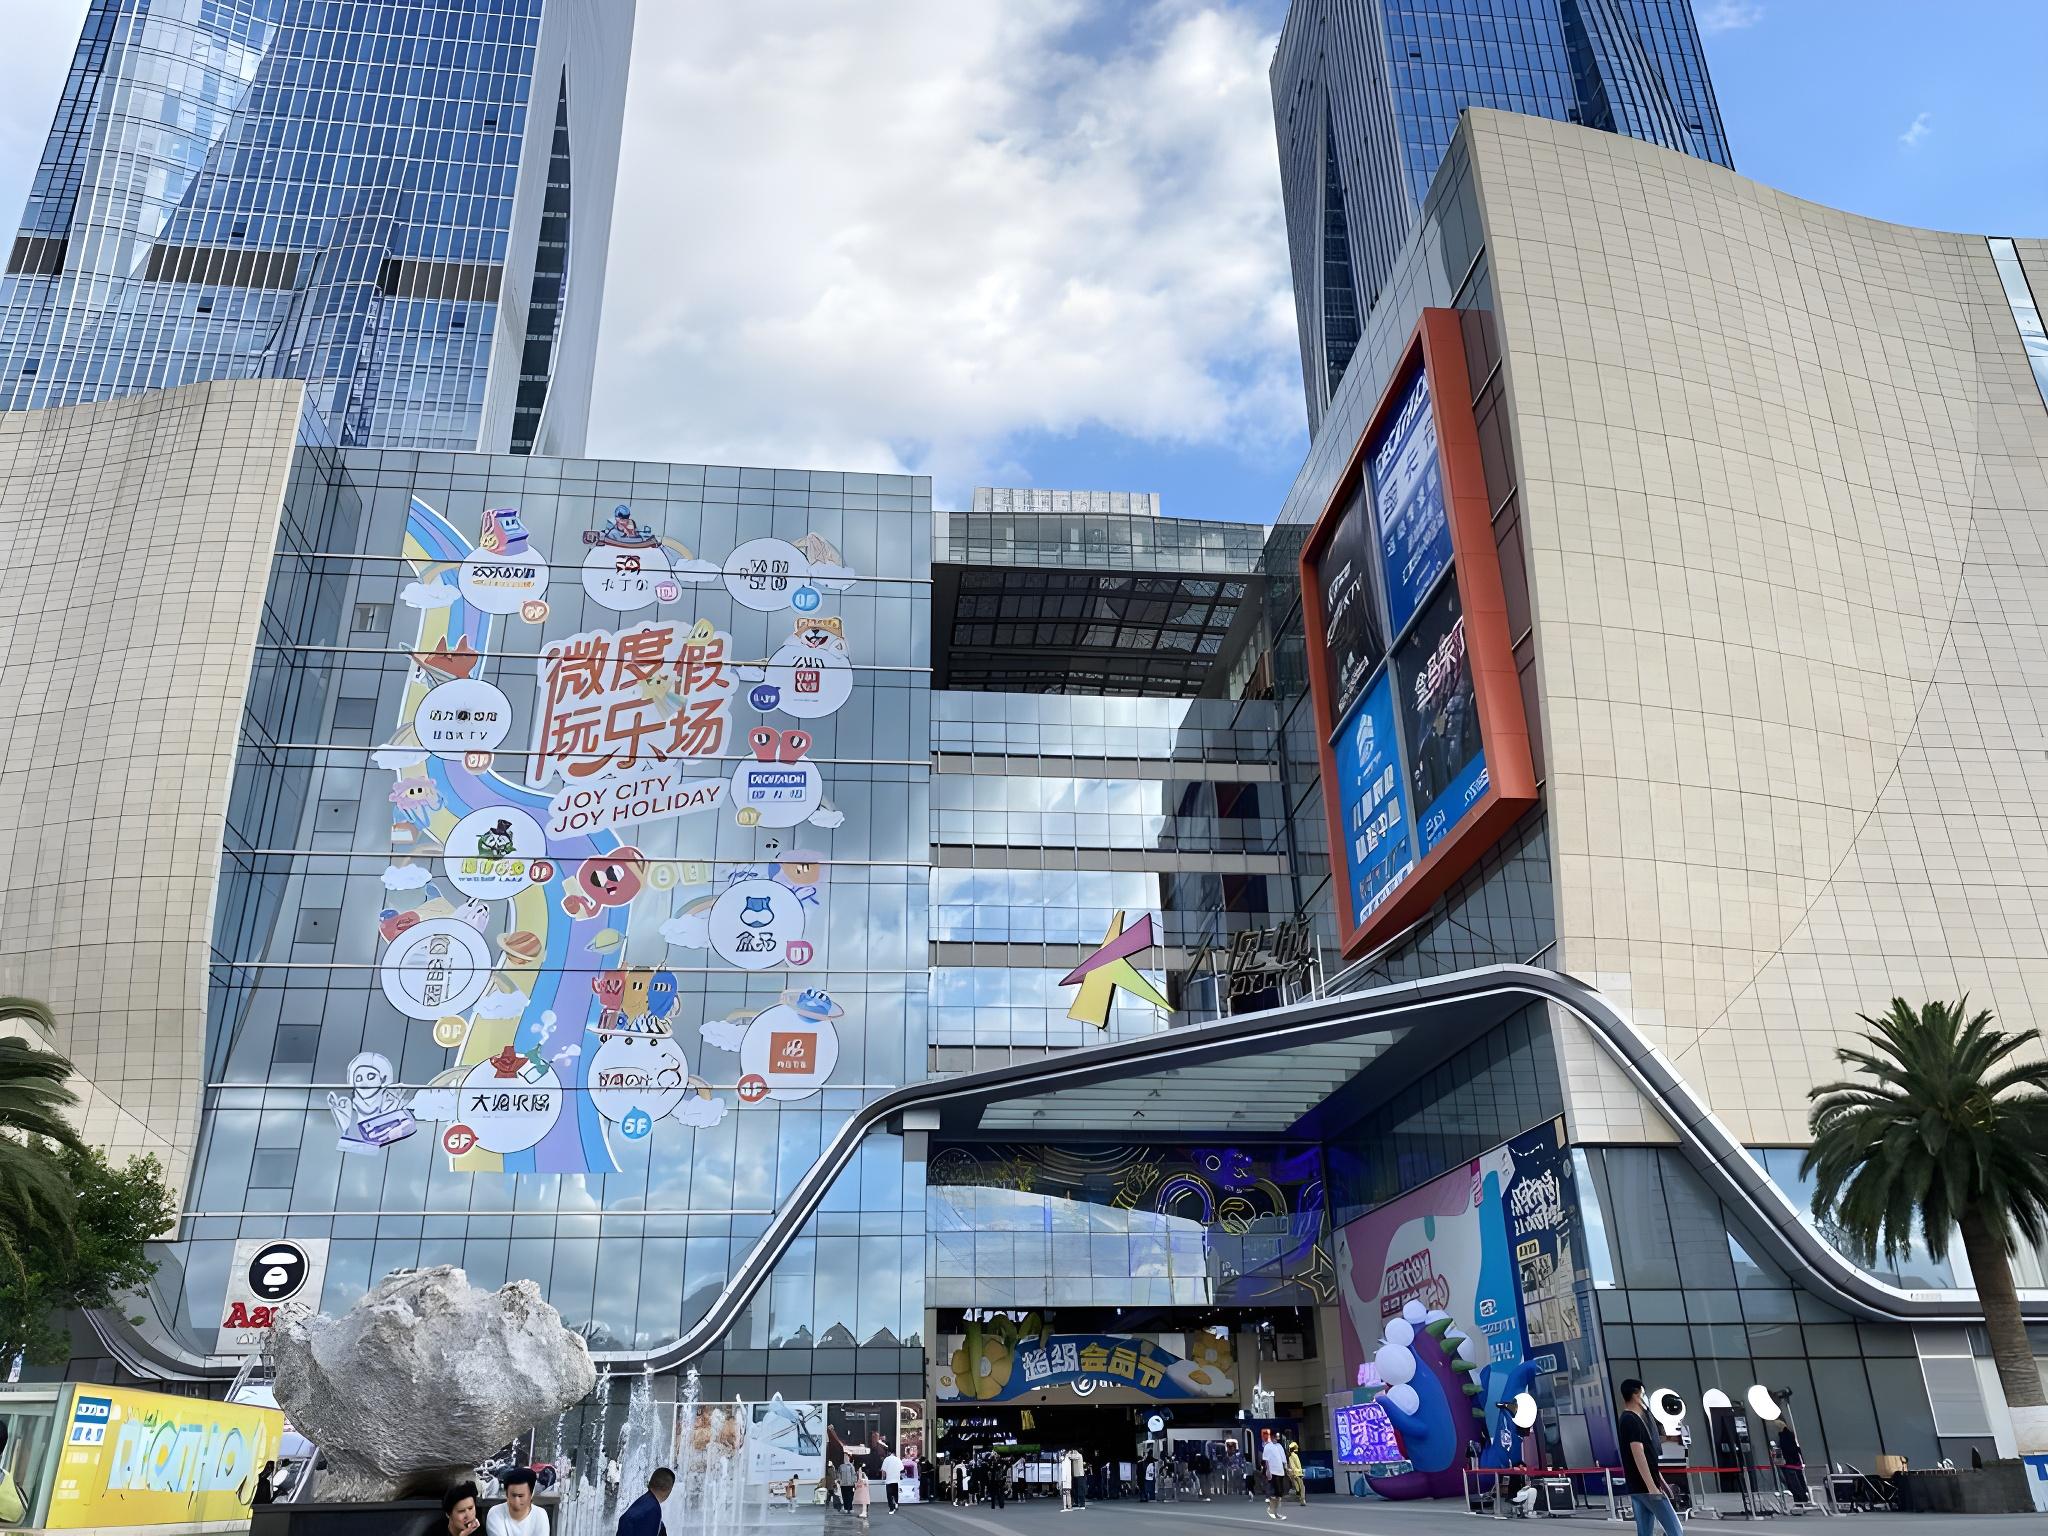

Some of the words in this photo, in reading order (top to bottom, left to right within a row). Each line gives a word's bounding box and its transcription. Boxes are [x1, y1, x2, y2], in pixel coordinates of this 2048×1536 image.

[546, 627, 730, 704] 微度假
[548, 698, 724, 777] 玩乐场
[554, 808, 605, 833] JOY
[612, 785, 721, 822] HOLIDAY
[557, 788, 608, 812] JOY
[615, 775, 672, 801] CITY
